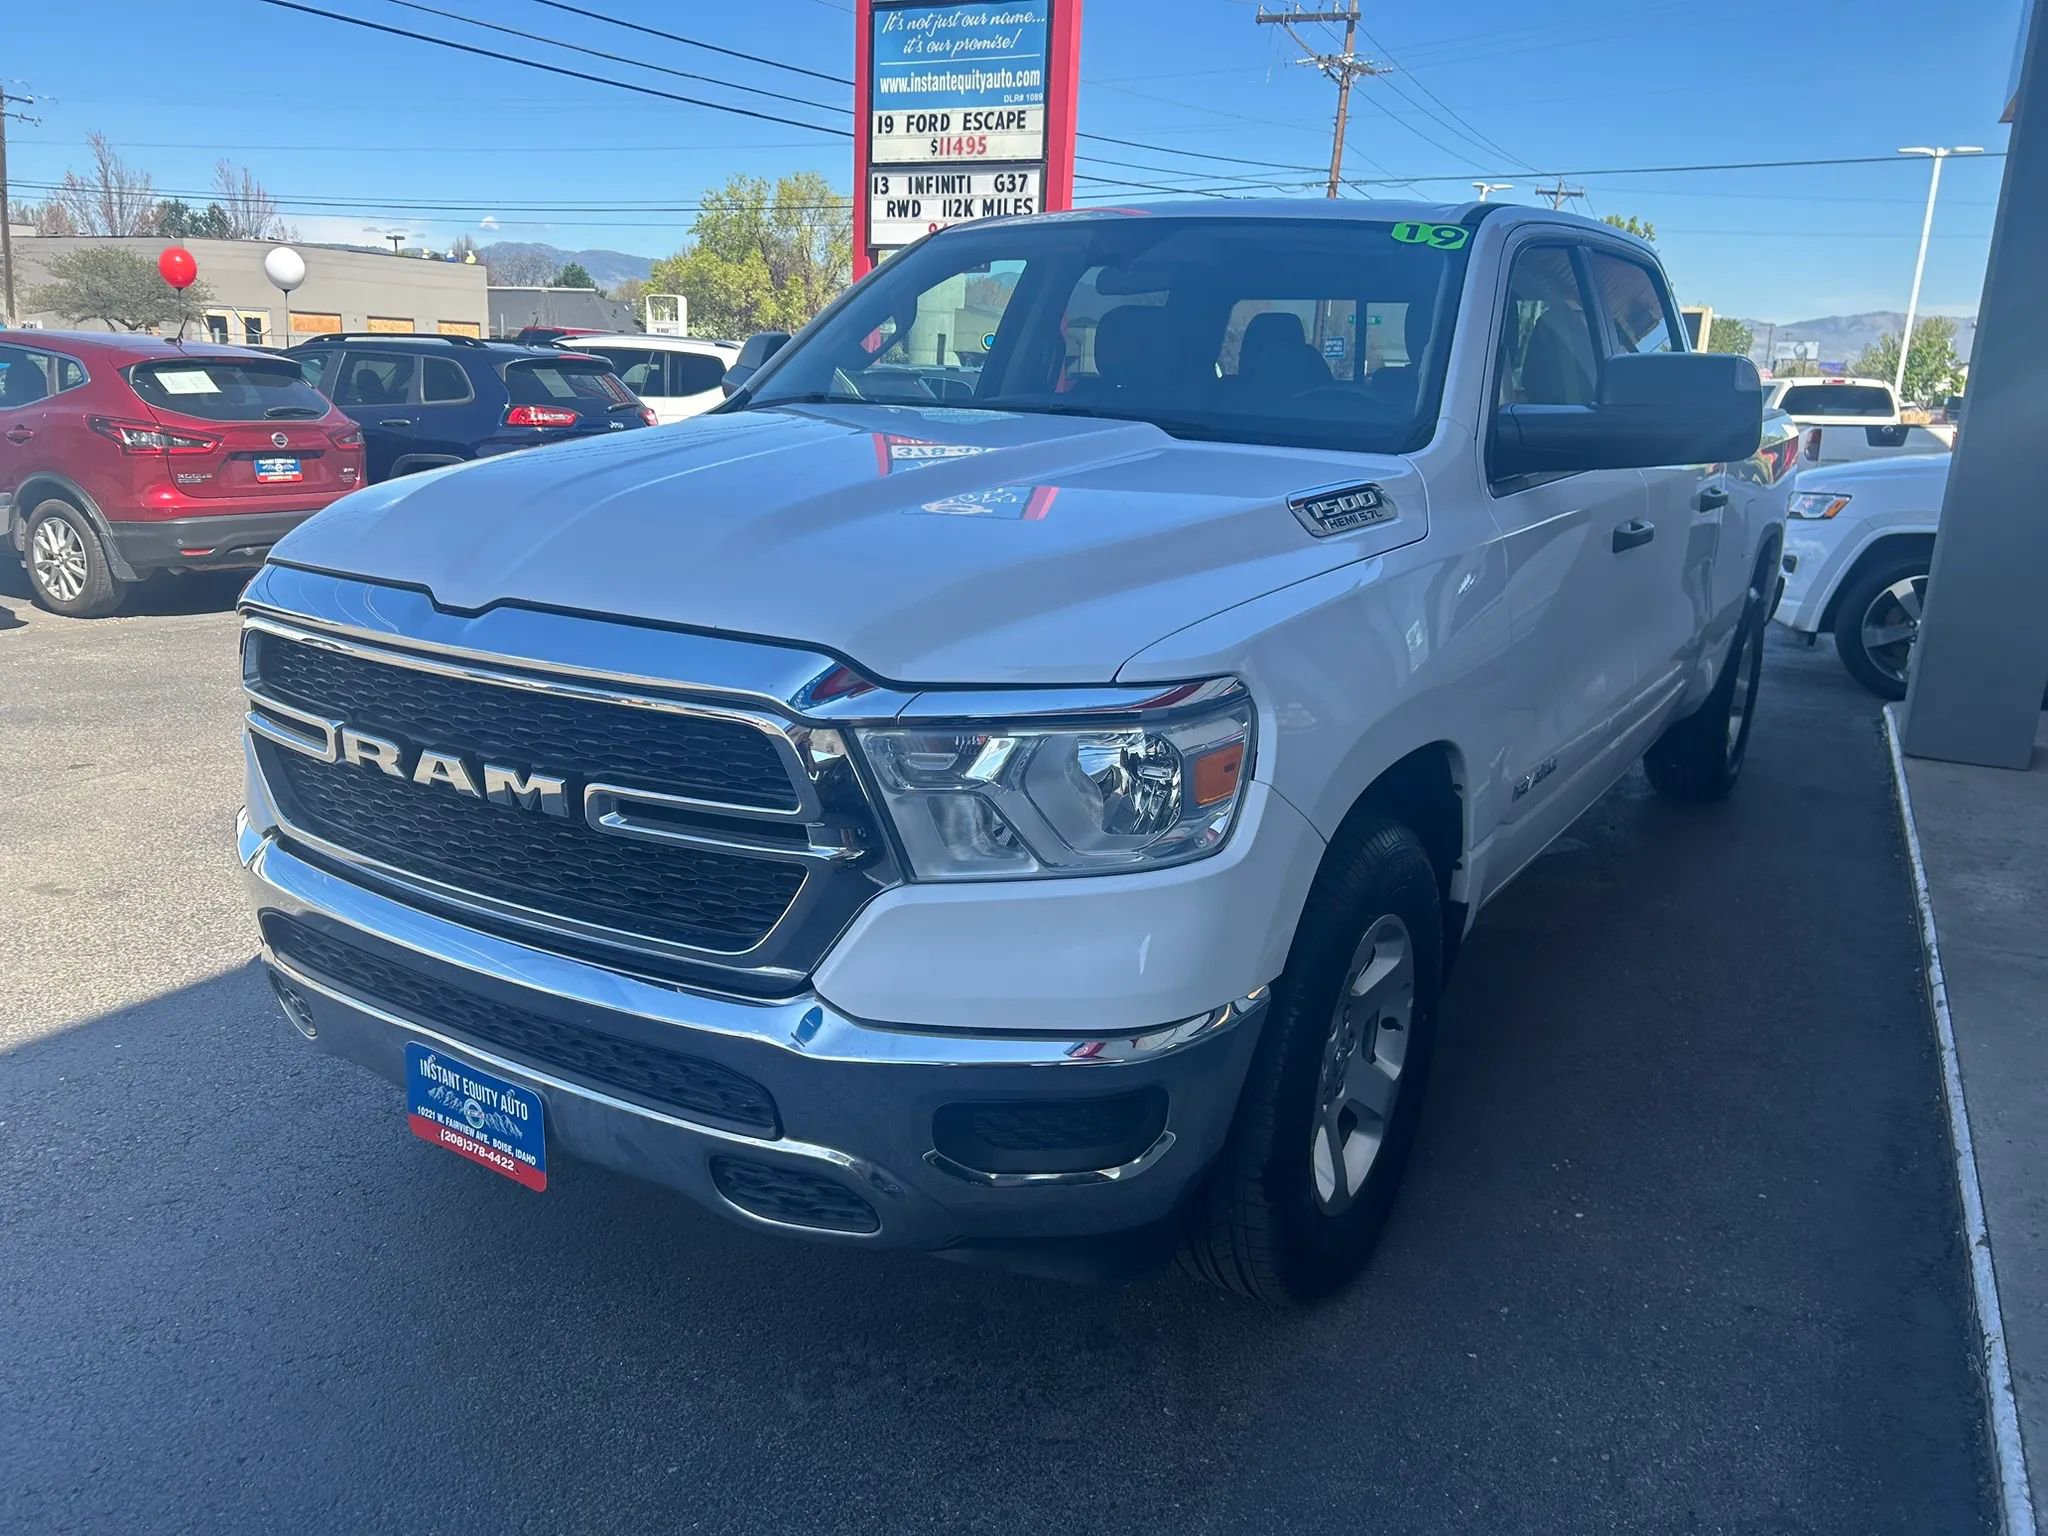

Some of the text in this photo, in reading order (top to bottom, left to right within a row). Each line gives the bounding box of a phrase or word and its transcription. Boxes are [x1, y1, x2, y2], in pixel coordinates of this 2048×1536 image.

[882, 11, 1046, 37] It's not just our name...
[903, 28, 1022, 58] it's our promise!
[880, 68, 1041, 95] www.instantequityauto.com
[1003, 92, 1043, 103] DLR# 1089
[877, 110, 1027, 134] 19 FORD ESCAPE
[930, 135, 987, 156] $11495
[874, 173, 1028, 195] 13 INFINITI G37
[887, 197, 1033, 218] RWD 112K MILES
[1404, 223, 1465, 247] 19
[1305, 490, 1379, 519] 1500
[1325, 514, 1359, 530] HEMI
[341, 728, 568, 818] RAM
[419, 1057, 528, 1121] INSTANT EQUITY AUTO
[440, 1128, 515, 1172] (208)378-4422
[445, 1116, 476, 1138] FAIRVIEW
[475, 1130, 490, 1145] AVE.
[492, 1138, 514, 1158] BOISE,
[515, 1148, 536, 1166] IDAHO
